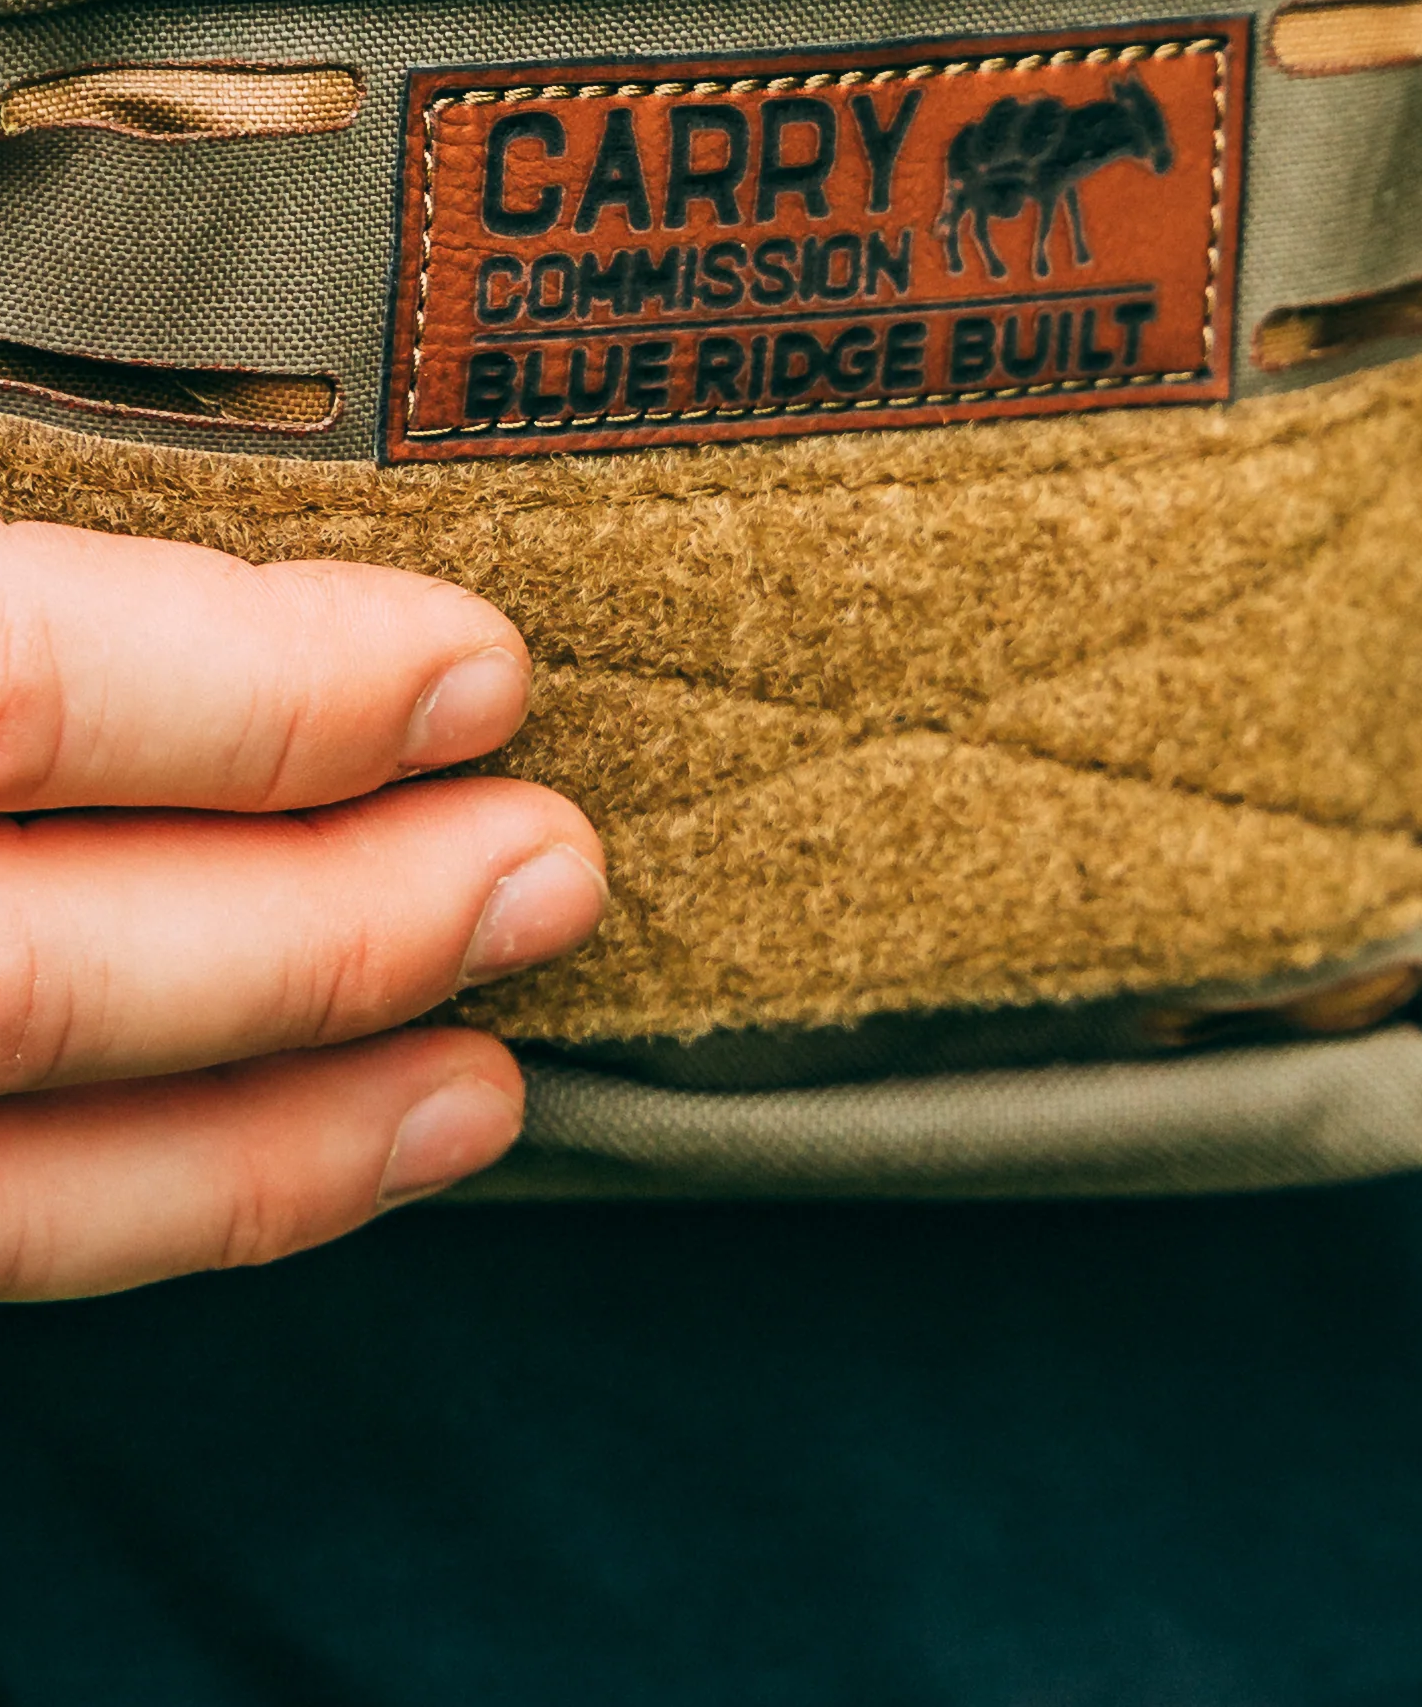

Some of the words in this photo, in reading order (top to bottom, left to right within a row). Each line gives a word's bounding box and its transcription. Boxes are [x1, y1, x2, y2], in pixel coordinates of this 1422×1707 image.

[482, 91, 924, 237] CARRY
[475, 231, 912, 325] COMMISSION
[465, 340, 674, 420] BLUE
[695, 322, 930, 405] RIDGE
[950, 301, 1157, 385] BUILT
